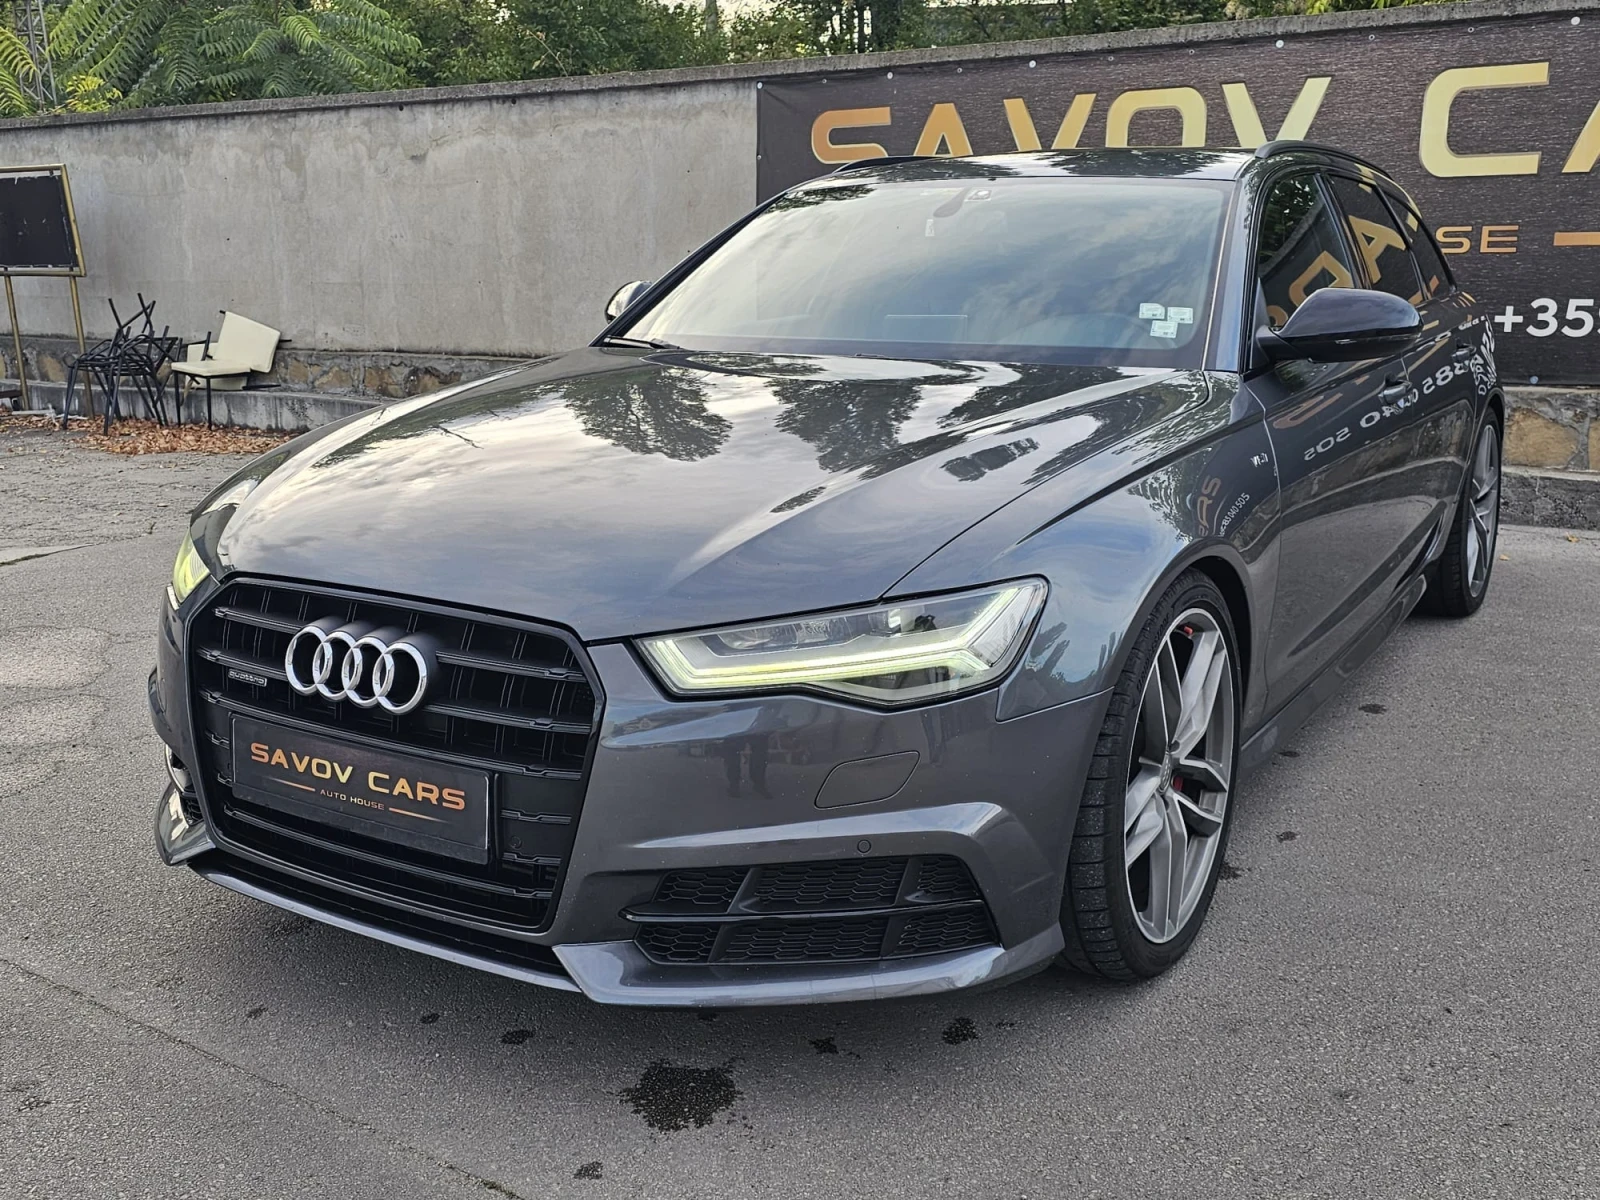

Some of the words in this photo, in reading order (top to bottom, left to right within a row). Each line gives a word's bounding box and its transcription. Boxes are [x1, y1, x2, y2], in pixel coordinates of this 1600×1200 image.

[250, 742, 353, 784] SAVOV
[368, 771, 466, 811] CARS
[320, 789, 347, 801] AUTO
[350, 796, 385, 811] HOUSE
